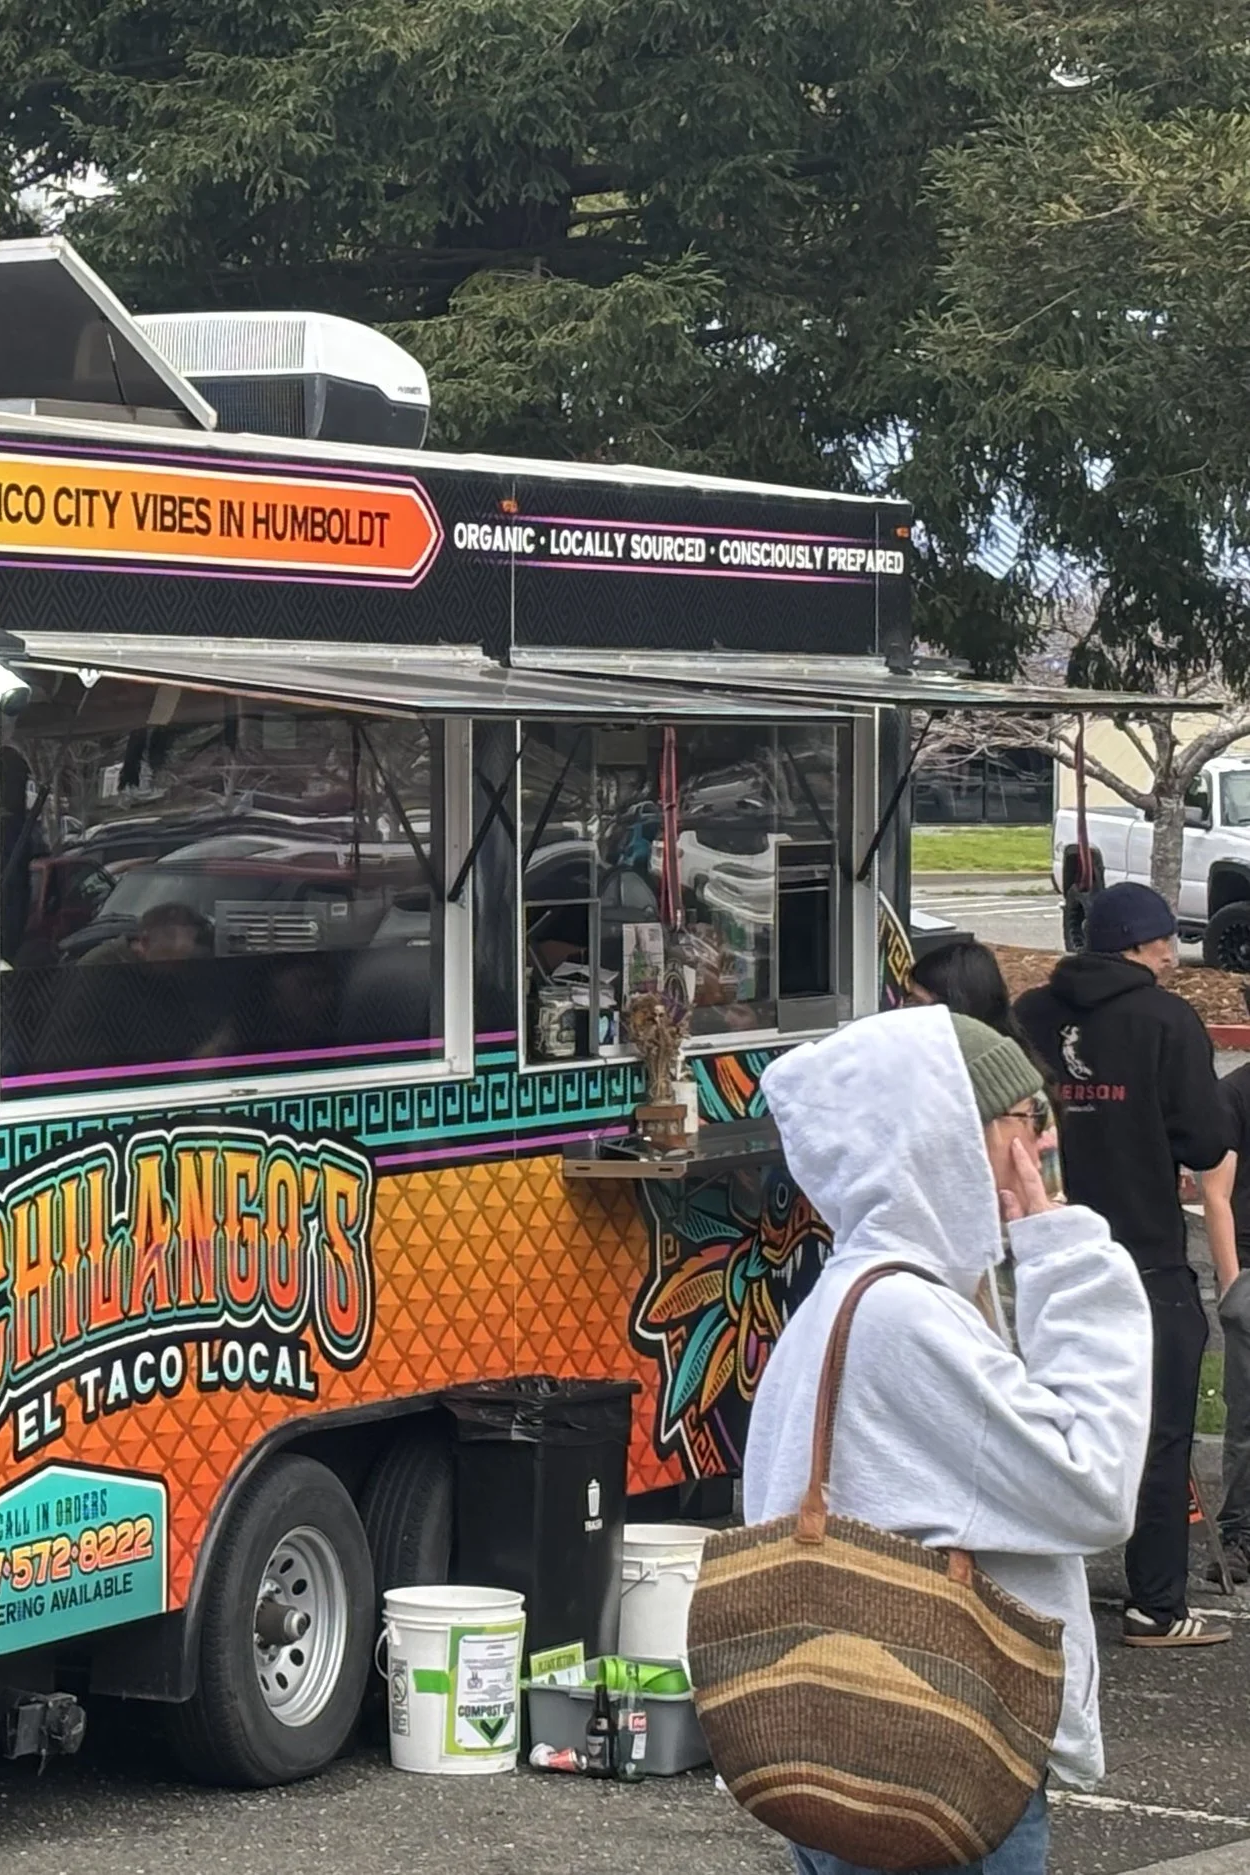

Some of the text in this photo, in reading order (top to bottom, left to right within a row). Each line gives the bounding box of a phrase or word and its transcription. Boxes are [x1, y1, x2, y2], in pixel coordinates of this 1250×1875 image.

[53, 487, 123, 529] CITY
[130, 491, 211, 537] VIBES
[219, 502, 245, 539] IN
[251, 502, 391, 548] HUMBOLDT
[453, 522, 905, 575] ORGANIC LOCALLY SOURCED CONSCIOUSLY PREPARED
[17, 1340, 318, 1452] EL TACO LOCAL
[36, 1500, 50, 1533] IN
[55, 1488, 108, 1528] ORDERS
[50, 1572, 133, 1613] AVAILABLE
[457, 1704, 501, 1718] COMPOST
